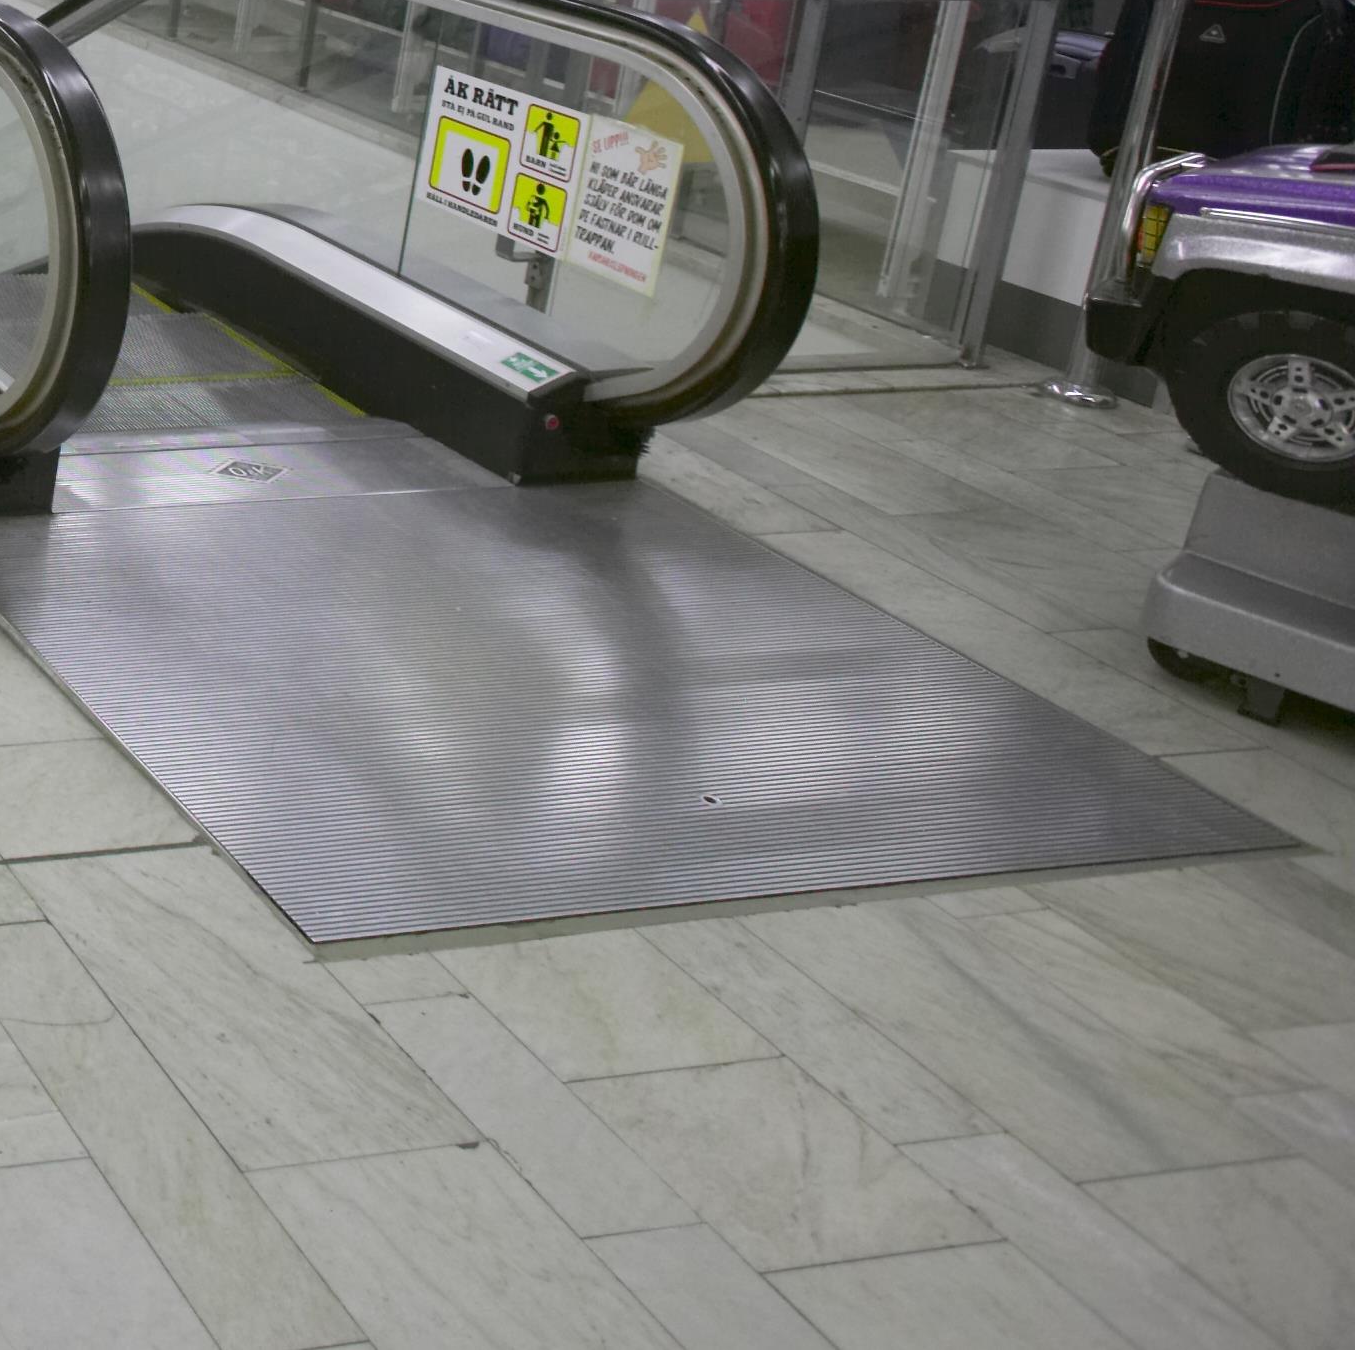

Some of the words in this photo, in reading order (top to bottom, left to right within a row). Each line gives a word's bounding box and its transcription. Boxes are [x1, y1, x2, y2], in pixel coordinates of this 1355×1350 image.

[444, 75, 469, 100] ÅK
[472, 87, 519, 116] RÄTT
[601, 165, 620, 181] SOM
[590, 212, 628, 238] FASTNAR
